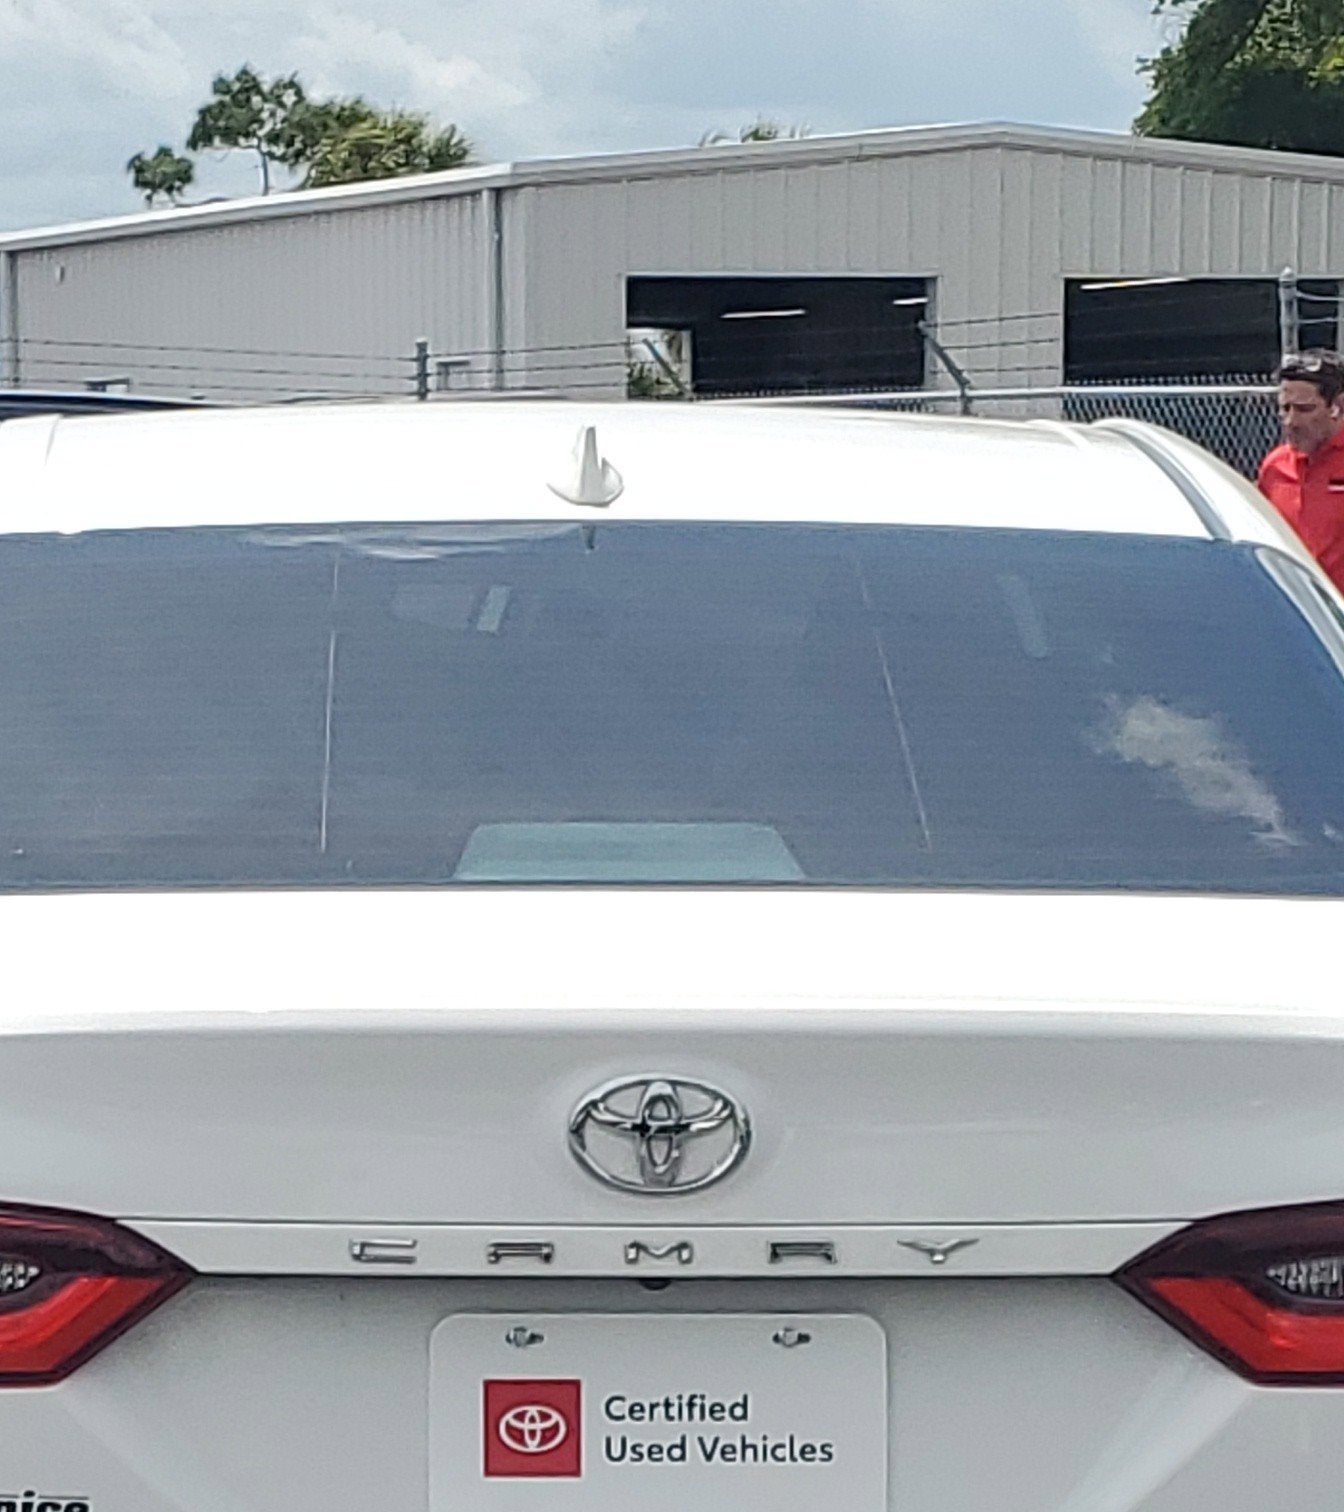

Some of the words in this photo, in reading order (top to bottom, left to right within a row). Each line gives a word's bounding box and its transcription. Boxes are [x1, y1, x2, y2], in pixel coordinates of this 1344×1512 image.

[604, 1394, 749, 1422] Certified
[604, 1436, 687, 1463] Used
[697, 1436, 834, 1463] Vehicles
